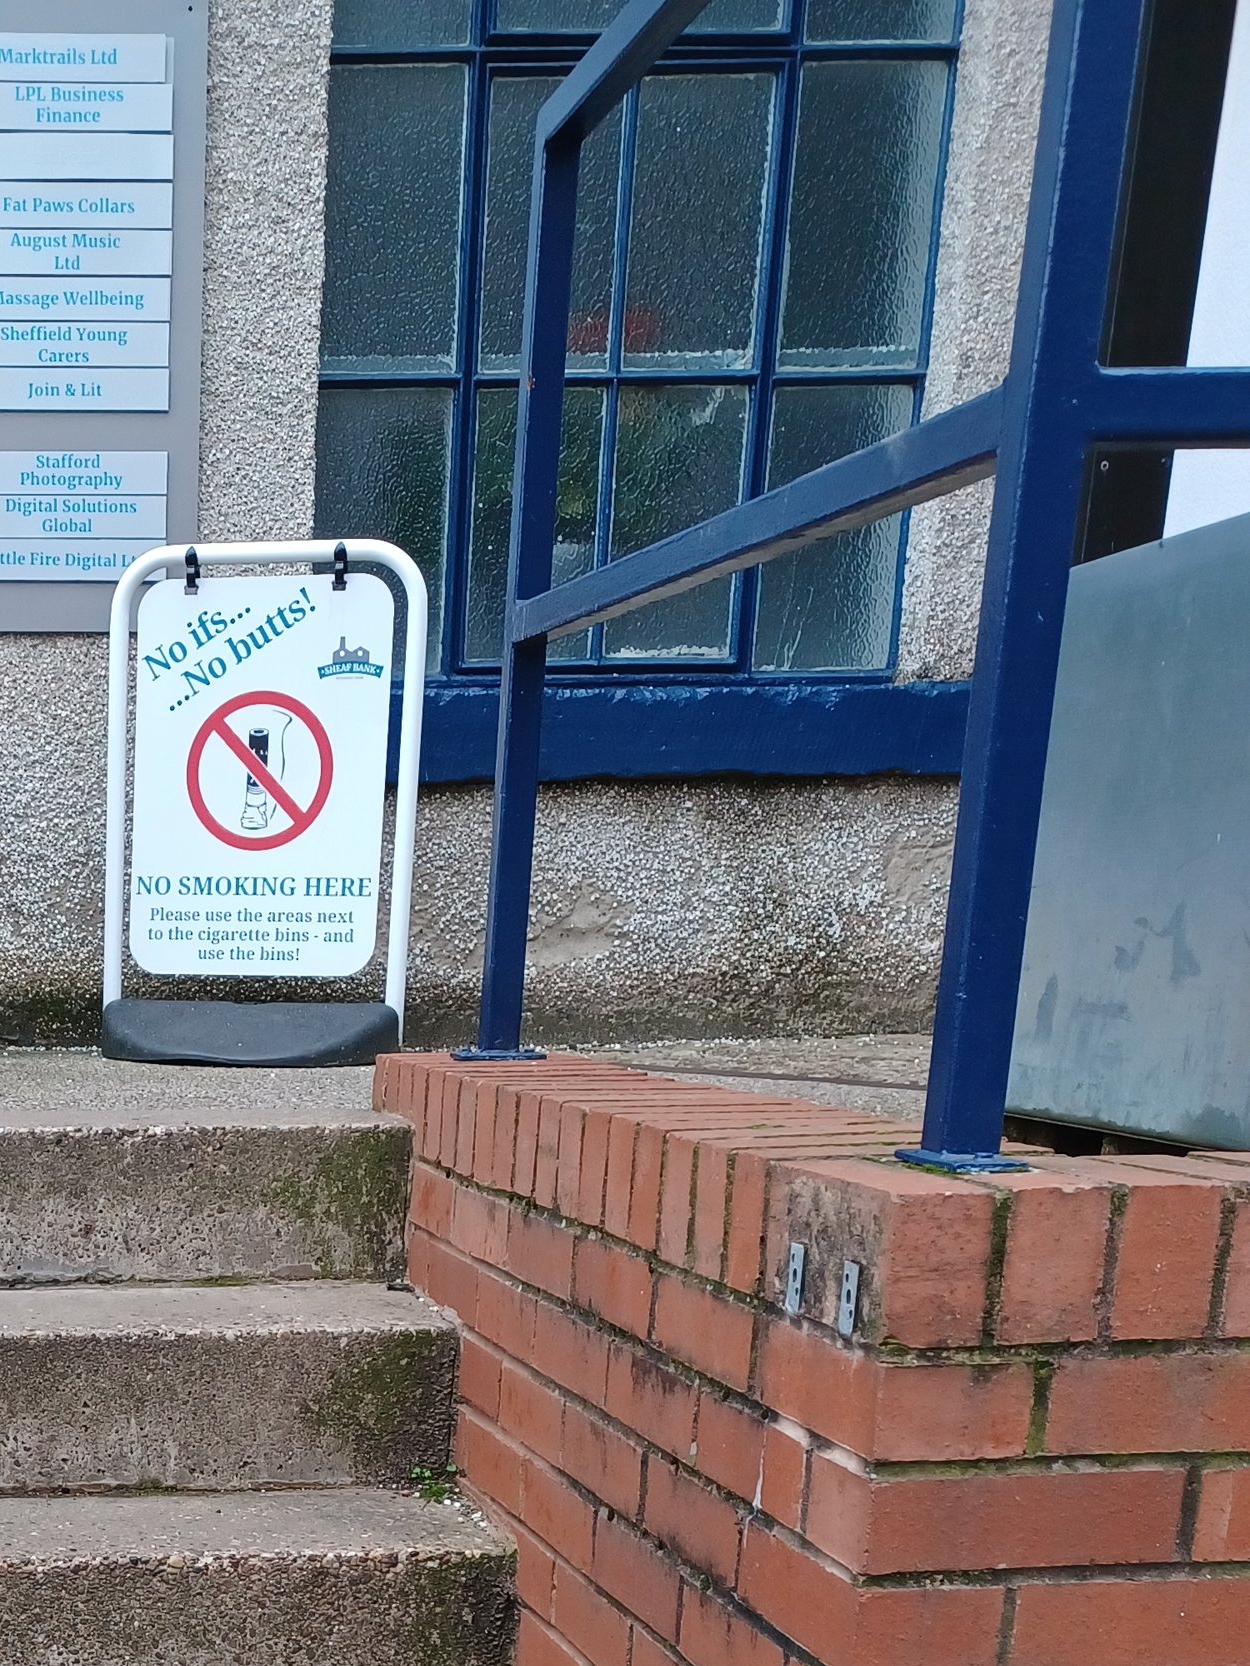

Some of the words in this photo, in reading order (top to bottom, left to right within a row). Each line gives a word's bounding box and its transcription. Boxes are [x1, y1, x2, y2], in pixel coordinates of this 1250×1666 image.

[90, 49, 117, 65] Ltd
[14, 86, 46, 101] LPL
[51, 86, 124, 102] Business
[35, 107, 100, 123] Finance
[3, 197, 27, 212] Fat
[32, 198, 74, 213] Paws
[78, 198, 135, 213] Collars
[10, 233, 67, 251] August
[71, 233, 121, 248] Music
[54, 255, 80, 270] Ltd
[63, 291, 144, 310] Wellbeing
[0, 326, 71, 341] Sheffield
[76, 328, 128, 346] Young
[38, 349, 90, 363] Carers
[27, 383, 59, 399] Join
[65, 383, 76, 397] &
[80, 383, 102, 397] Lit
[36, 454, 100, 469] Stafford
[20, 472, 123, 490] Photography
[5, 498, 58, 516] Digital
[62, 499, 137, 513] Solutions
[42, 518, 92, 533] Global
[30, 552, 60, 566] Fire
[65, 553, 116, 571] Digital
[224, 587, 316, 666] butts!
[142, 641, 188, 681] No
[324, 663, 352, 675] SHEAF
[352, 663, 376, 675] BANK
[135, 876, 171, 896] NO
[178, 876, 296, 897] SMOKING
[304, 877, 372, 897] HERE
[149, 907, 200, 922] Please
[205, 911, 232, 922] use
[237, 908, 263, 922] the
[267, 912, 312, 923] areas
[317, 910, 354, 924] next
[148, 928, 163, 940] to
[168, 927, 193, 940] the
[198, 927, 270, 944] cigarette
[274, 928, 309, 942] bins
[323, 929, 354, 943] and
[198, 949, 225, 960] use
[230, 946, 255, 960] the
[260, 947, 300, 961] bins!
